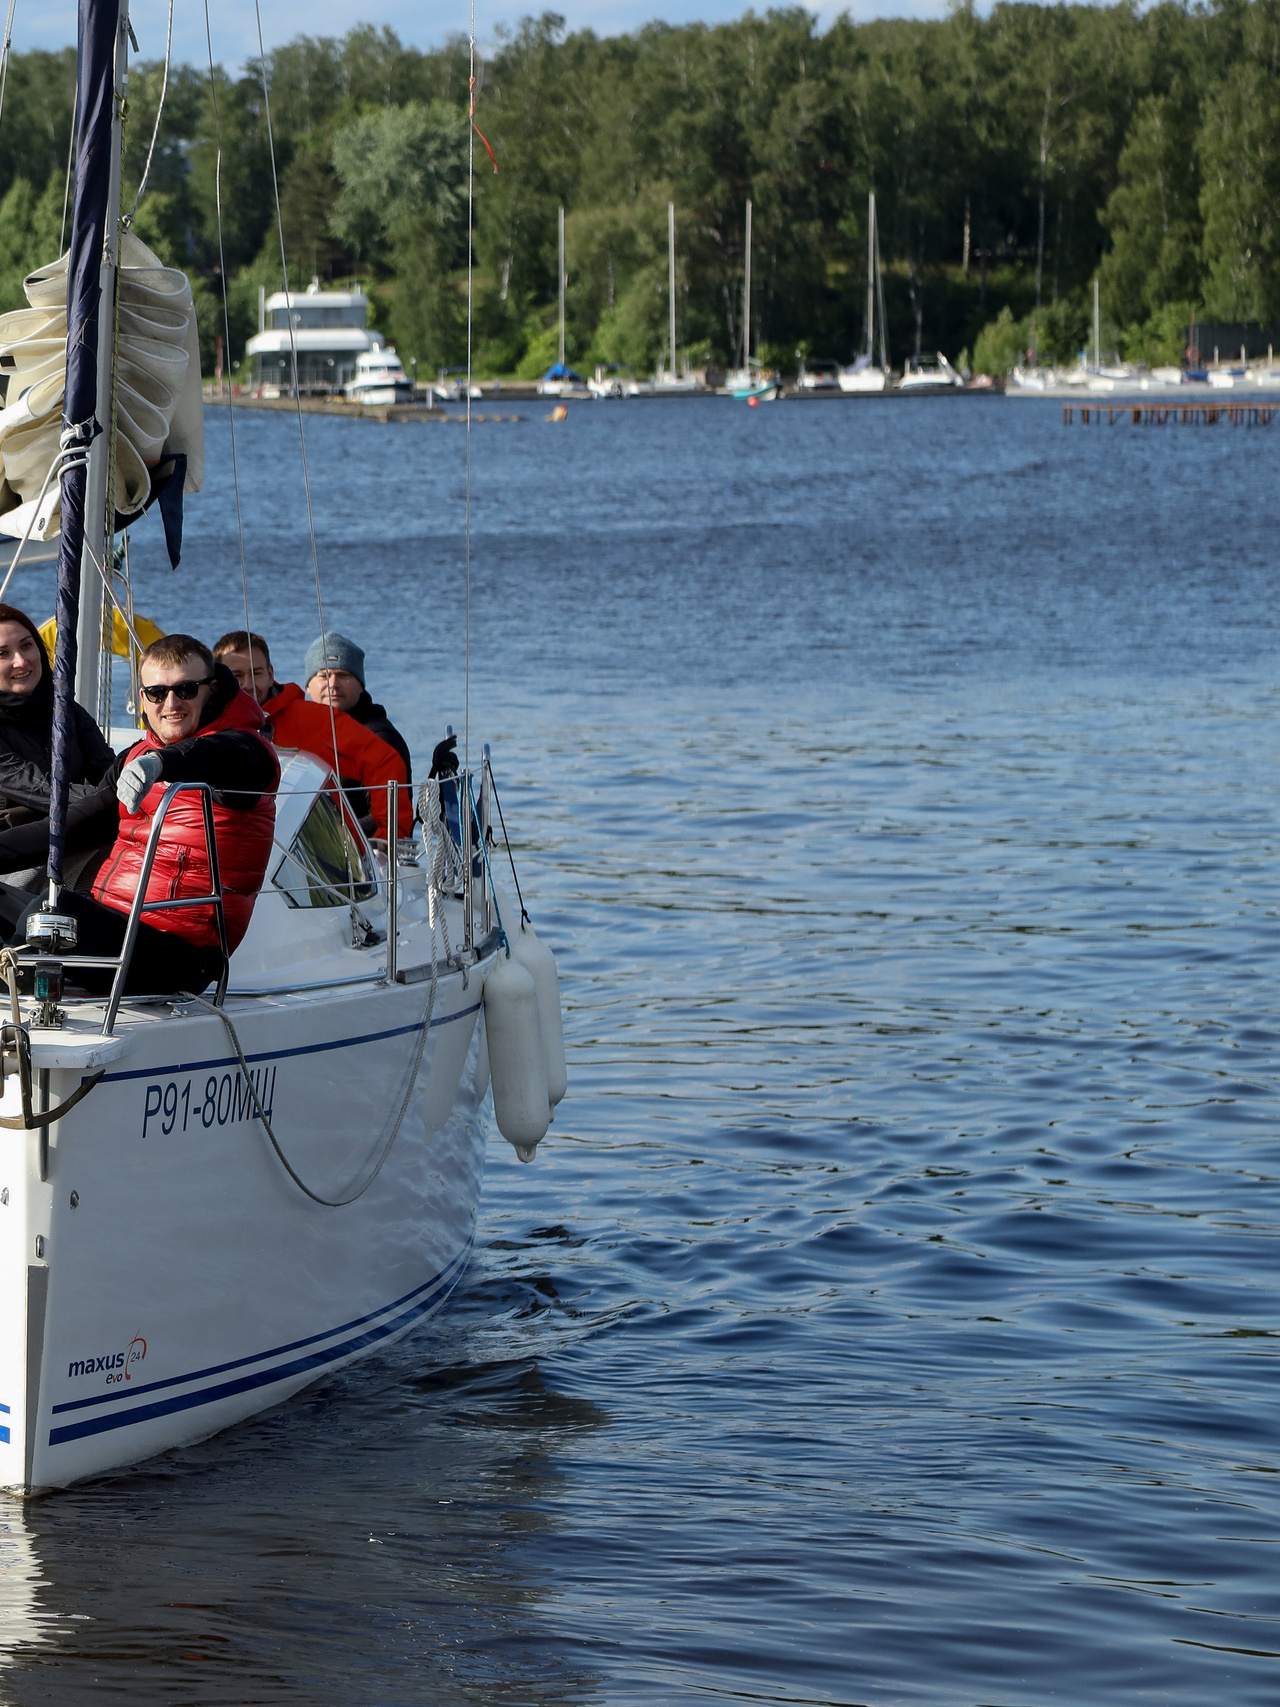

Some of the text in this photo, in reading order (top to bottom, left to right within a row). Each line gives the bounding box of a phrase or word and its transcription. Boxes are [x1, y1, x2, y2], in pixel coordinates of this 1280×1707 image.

[68, 1351, 140, 1377] maxus 24
[105, 1373, 123, 1384] evo
